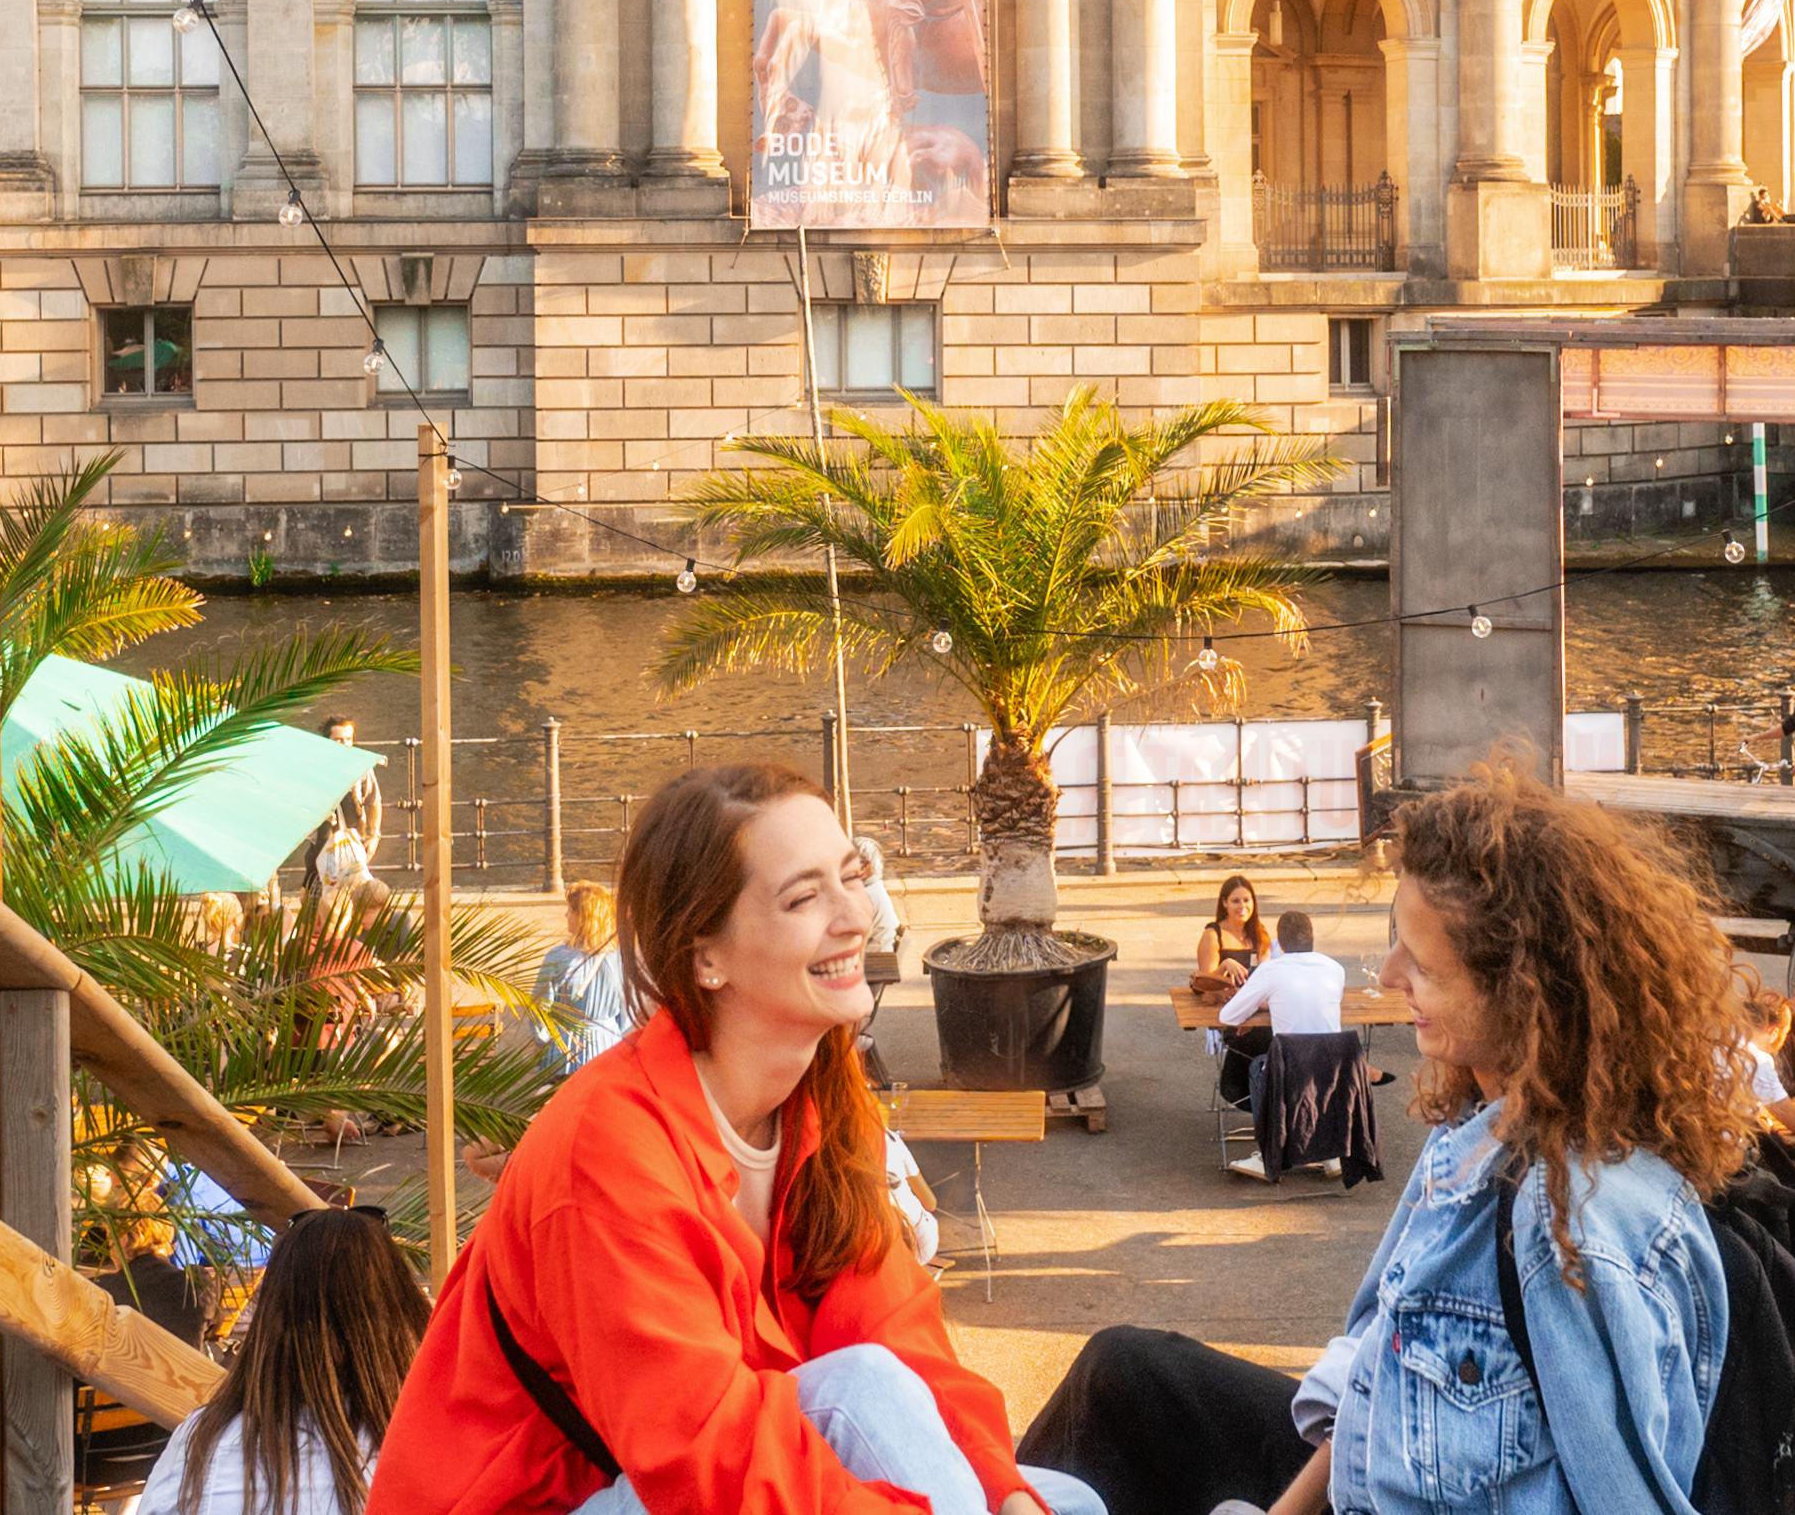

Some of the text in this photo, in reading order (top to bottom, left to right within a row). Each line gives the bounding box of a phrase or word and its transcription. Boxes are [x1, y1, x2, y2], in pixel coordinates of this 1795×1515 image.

[769, 133, 839, 157] BODE
[768, 162, 888, 186] MUSEUM
[769, 191, 933, 204] MUSEUMSINSEL BERLIN
